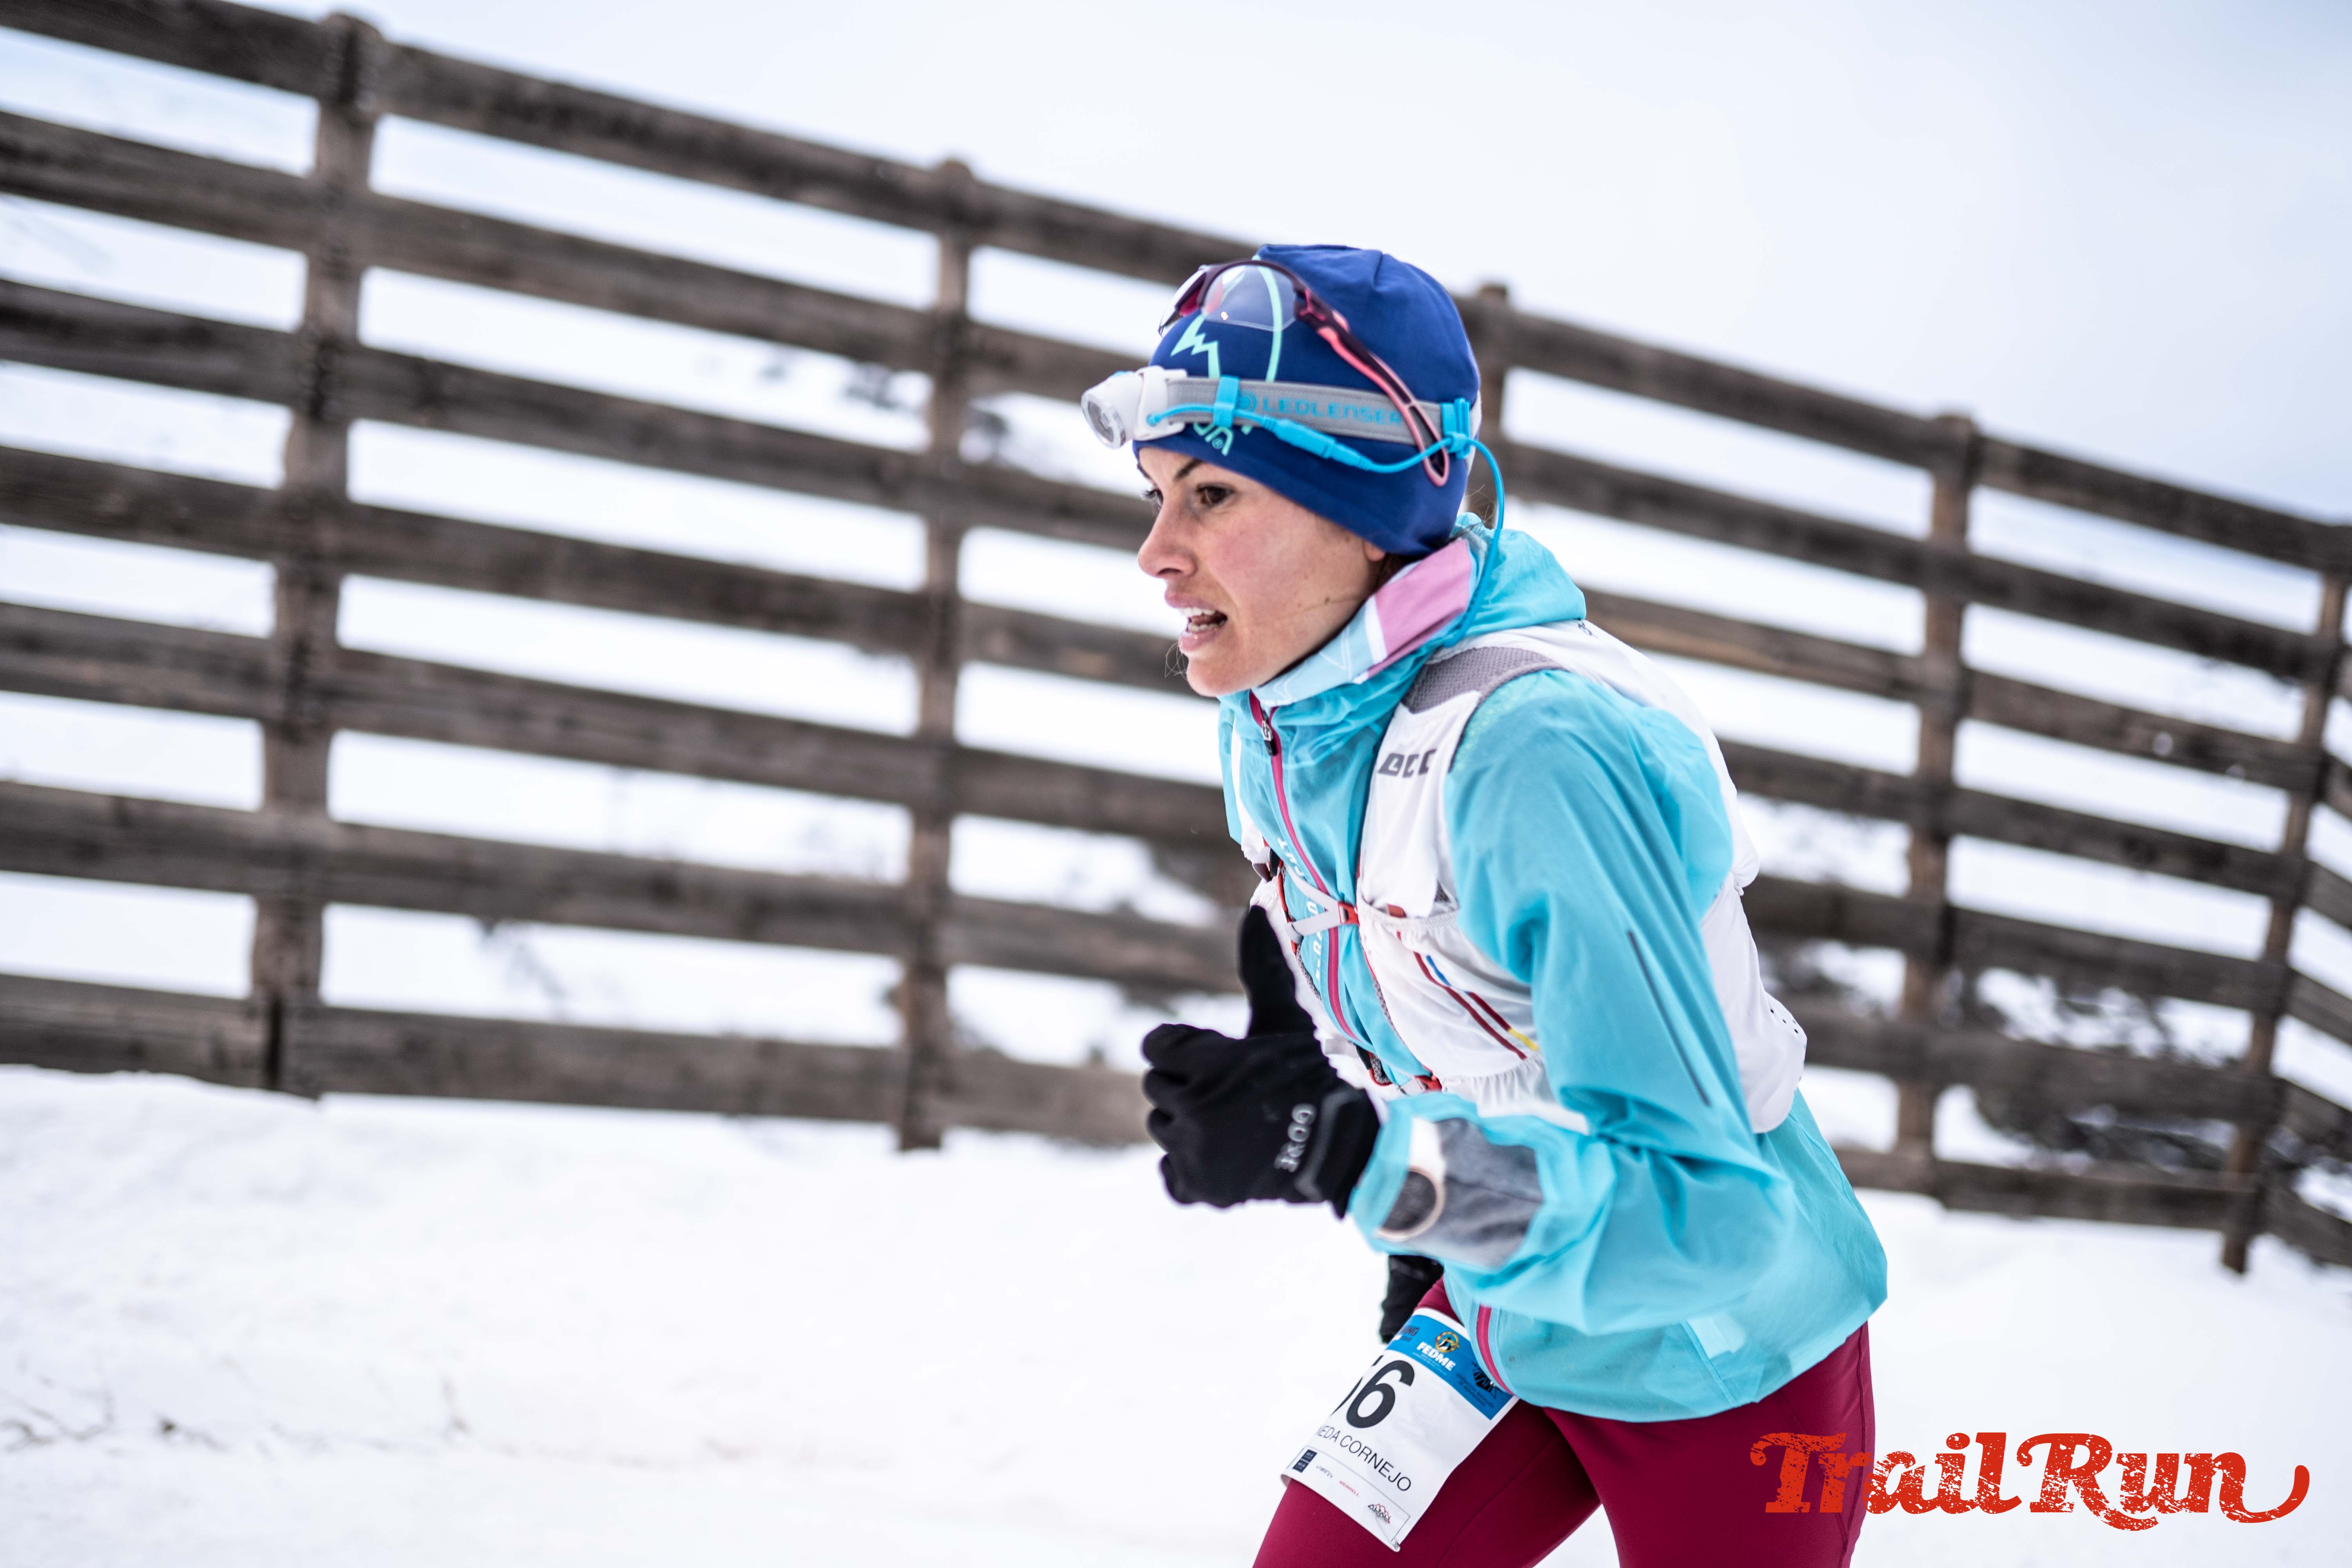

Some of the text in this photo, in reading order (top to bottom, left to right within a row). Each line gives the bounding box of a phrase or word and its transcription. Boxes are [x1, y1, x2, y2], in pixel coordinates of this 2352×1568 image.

[1416, 1341, 1456, 1371] FEDME
[1330, 1355, 1415, 1428] 6
[1316, 1425, 1340, 1443] EDA
[1340, 1435, 1412, 1491] CORNEJO
